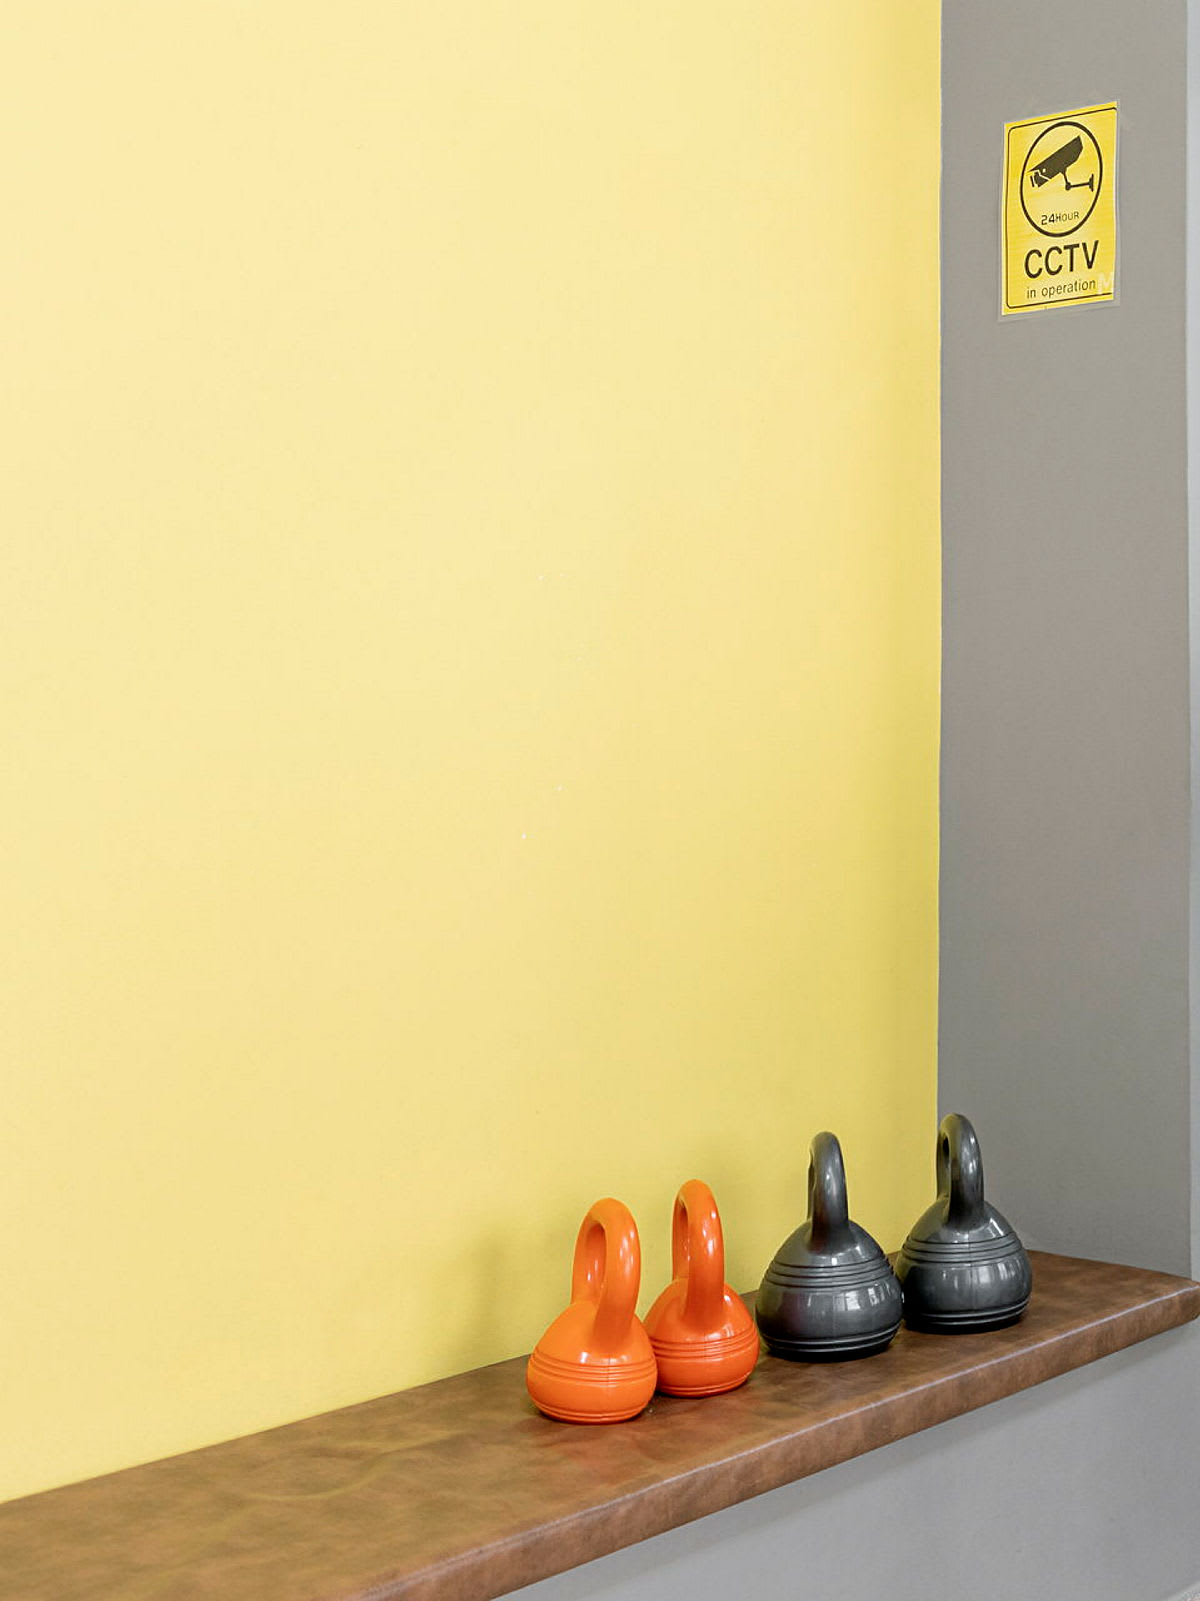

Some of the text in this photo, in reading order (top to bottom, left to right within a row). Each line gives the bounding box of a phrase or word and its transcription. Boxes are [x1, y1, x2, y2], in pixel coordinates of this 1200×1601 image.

[1041, 211, 1080, 225] 24HOUR
[1024, 240, 1099, 279] CCTV
[1027, 279, 1096, 299] in operation
